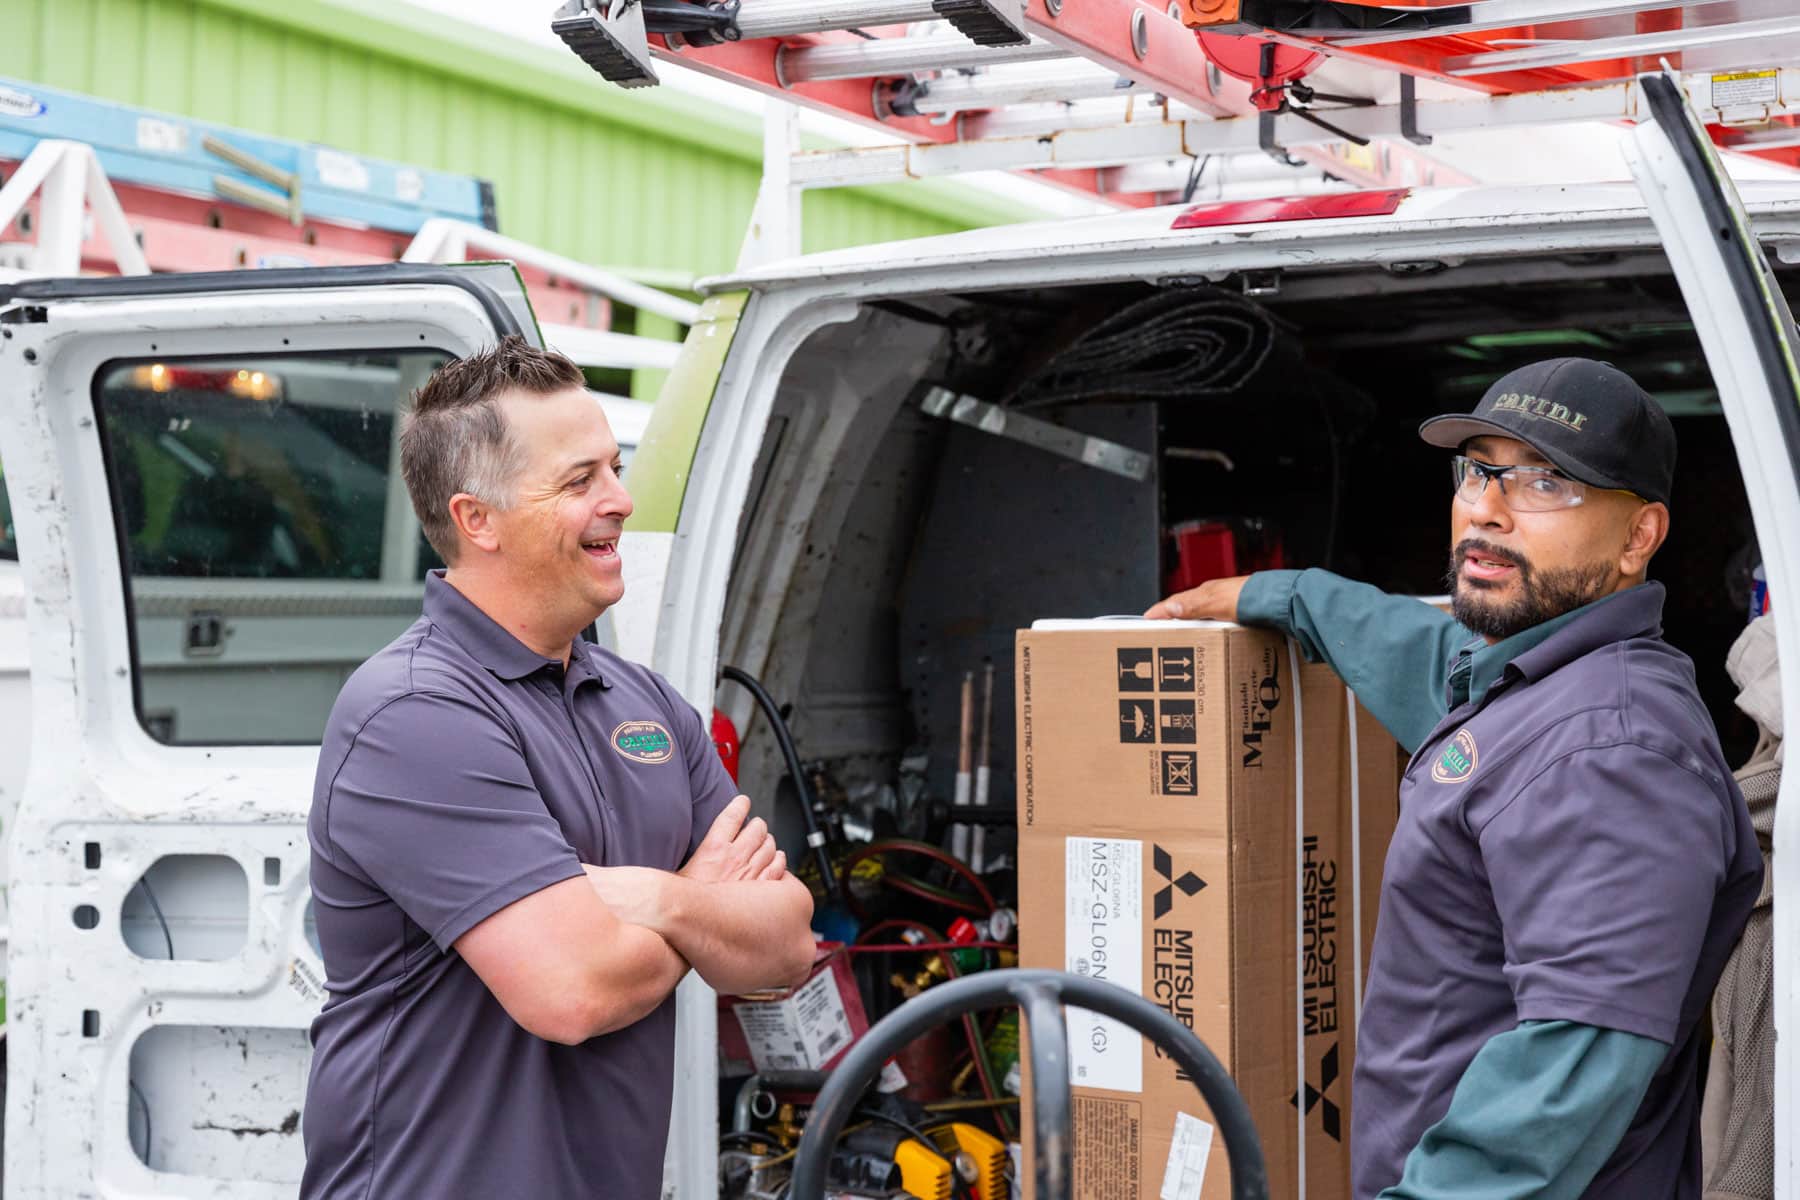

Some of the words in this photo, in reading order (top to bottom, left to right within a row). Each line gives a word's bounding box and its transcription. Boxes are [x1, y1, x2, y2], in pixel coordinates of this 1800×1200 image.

[1023, 646, 1033, 701] MITSUBISHI
[1023, 704, 1033, 752] ELECTRIC
[1025, 754, 1035, 826] CORPORATION
[1091, 841, 1108, 980] MSZ-GL06N
[1318, 859, 1337, 1034] ELECTRIC
